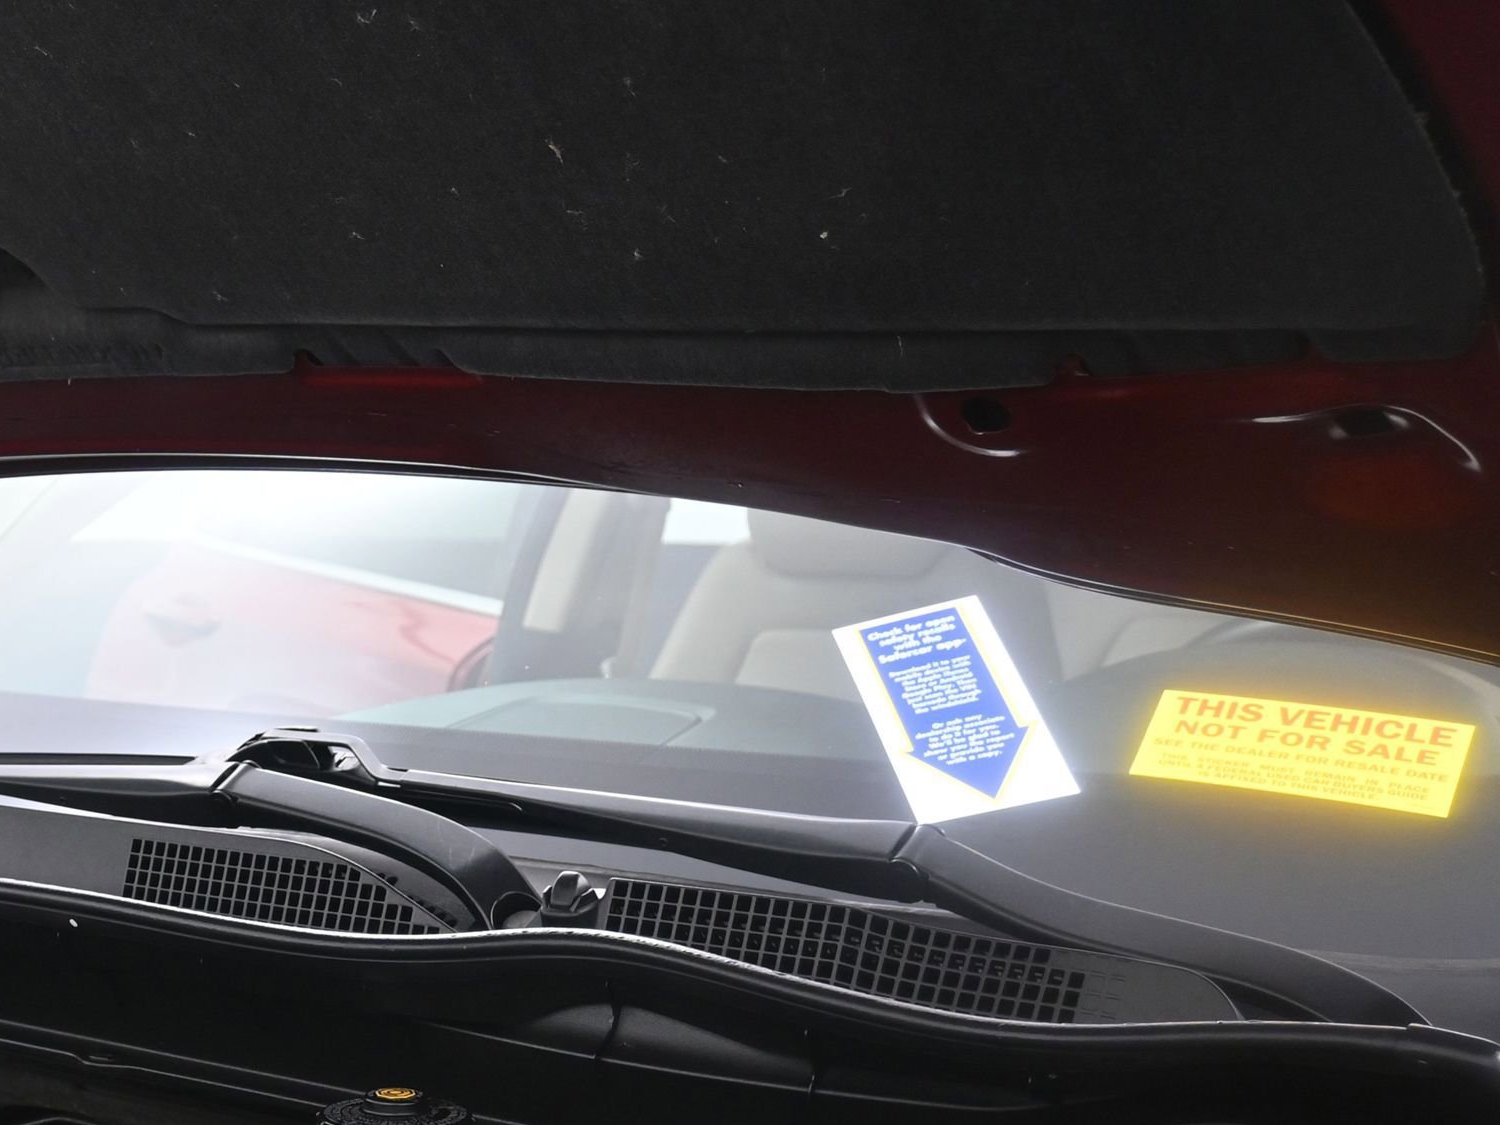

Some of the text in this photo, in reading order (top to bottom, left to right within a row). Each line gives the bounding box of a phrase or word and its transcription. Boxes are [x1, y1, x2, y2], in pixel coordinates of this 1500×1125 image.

[1174, 719, 1439, 765] NOT FOR SALE
[1177, 695, 1456, 746] THIS VEHICLE
[1153, 736, 1450, 782] SEE THE DEALER FOR RESALE DATE
[1364, 777, 1380, 785] IN
[1388, 781, 1431, 793] PLACE
